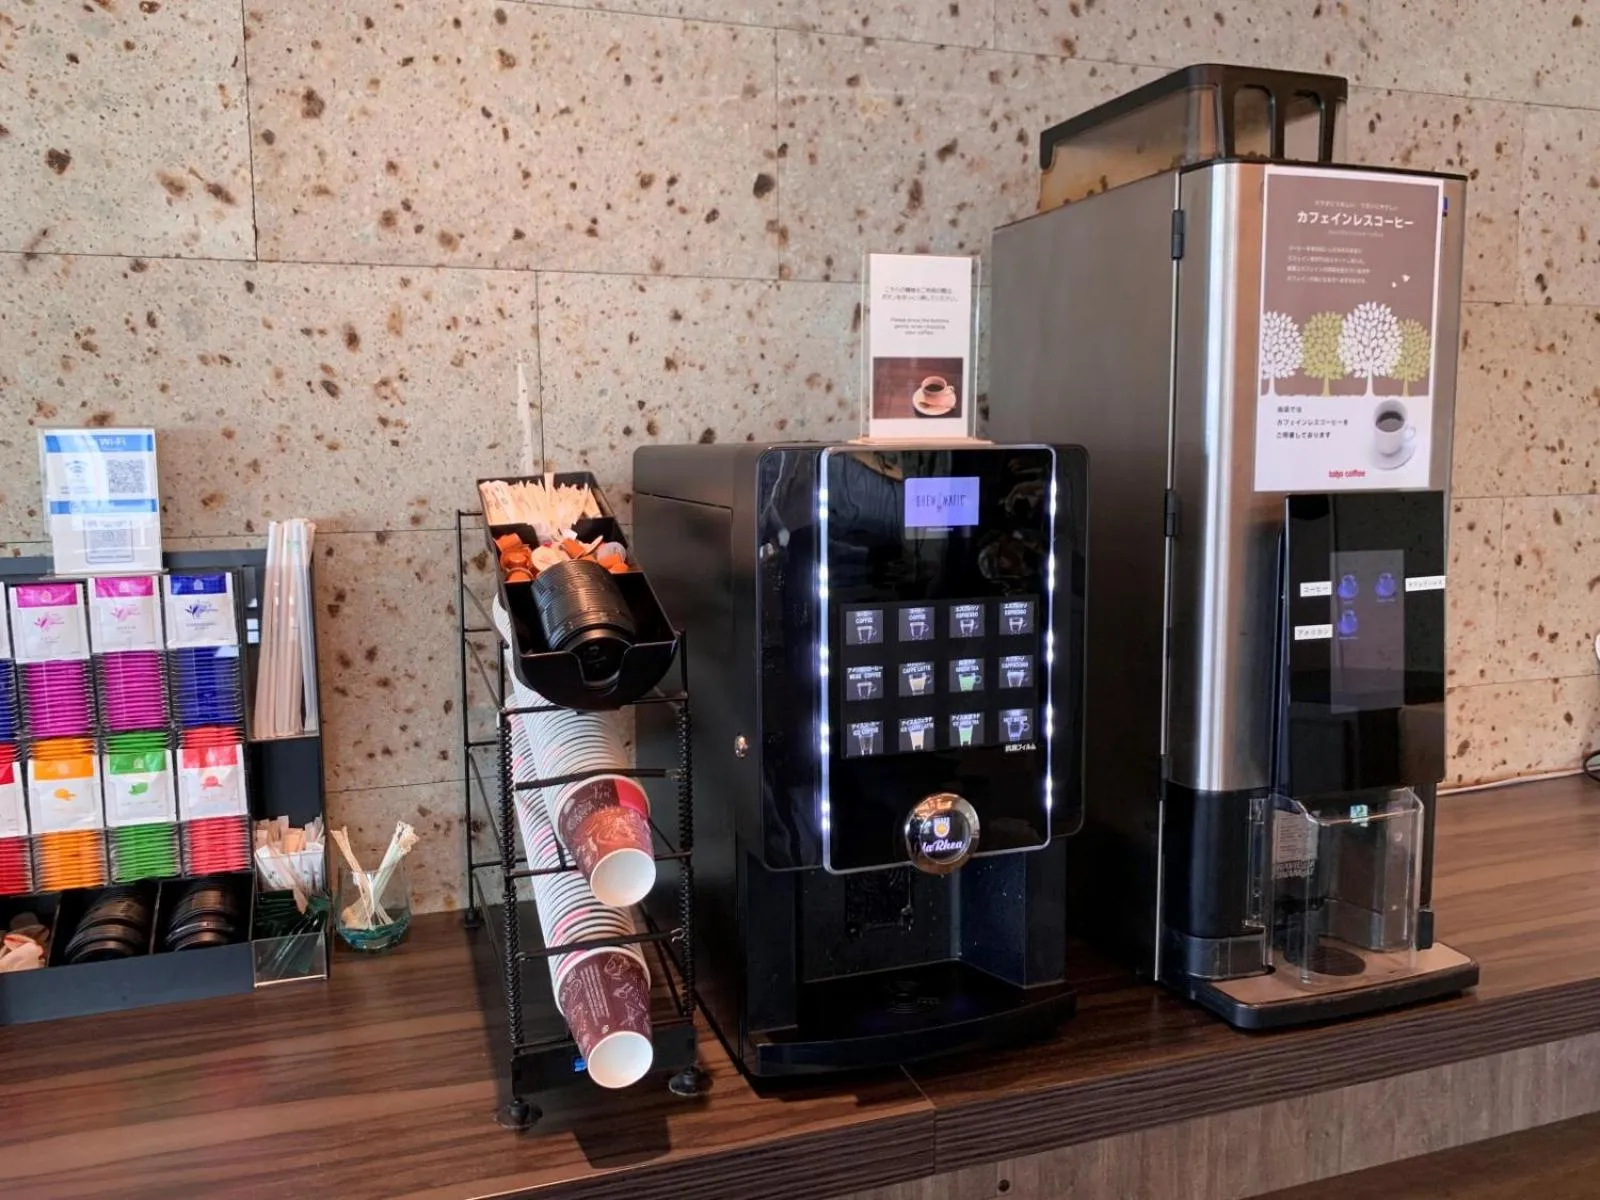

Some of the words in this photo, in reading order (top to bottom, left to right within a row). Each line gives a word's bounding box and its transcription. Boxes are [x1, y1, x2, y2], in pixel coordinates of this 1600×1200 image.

[1297, 210, 1414, 229] カフェインレスコーヒー
